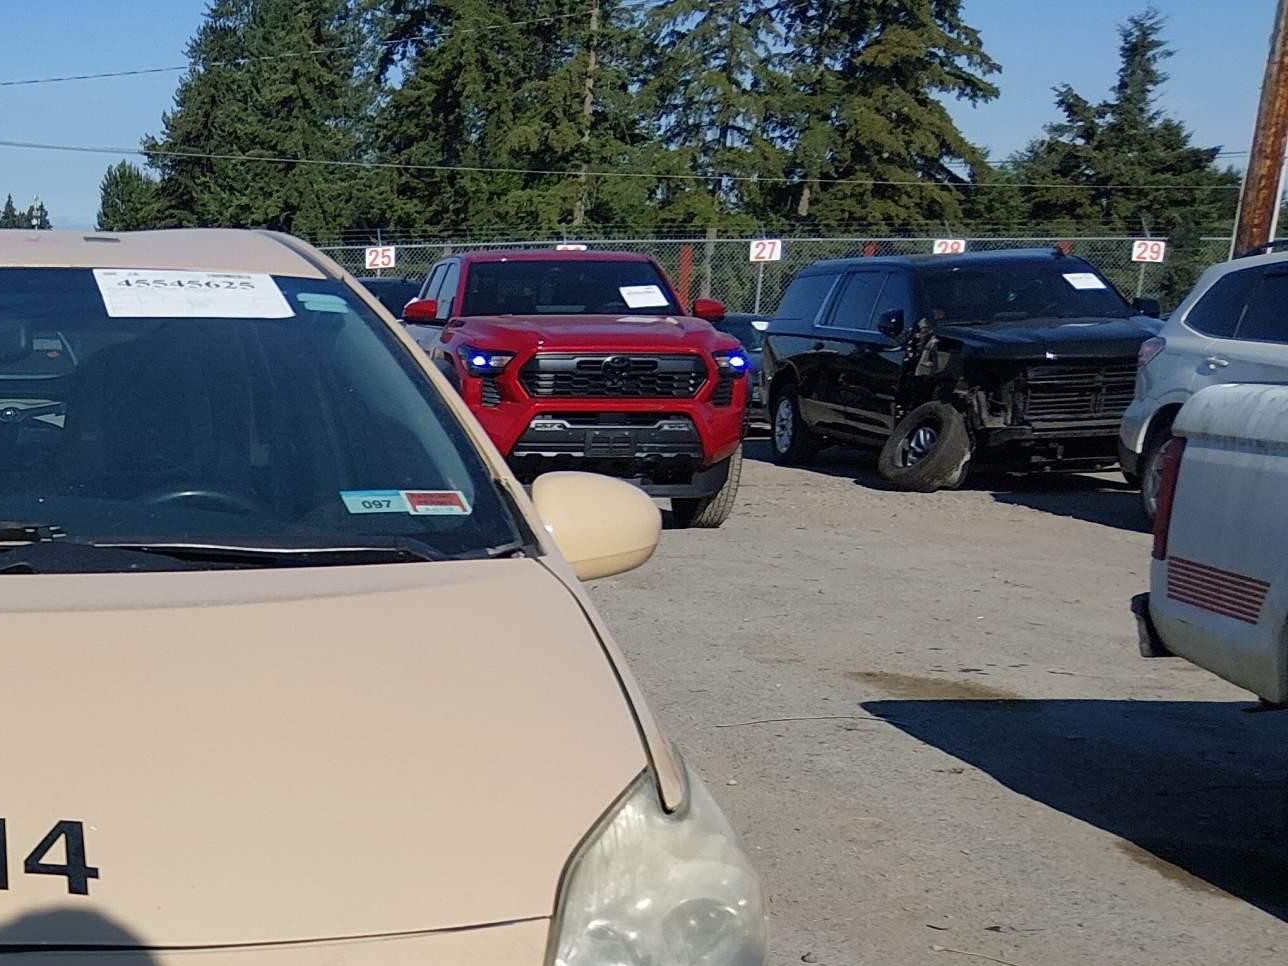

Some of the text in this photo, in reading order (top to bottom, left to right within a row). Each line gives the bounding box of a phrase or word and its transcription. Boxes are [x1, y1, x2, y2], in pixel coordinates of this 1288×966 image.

[368, 248, 392, 267] 25
[754, 242, 777, 260] 27
[1136, 242, 1161, 260] 29
[118, 278, 256, 290] 45545625
[362, 499, 392, 509] 097
